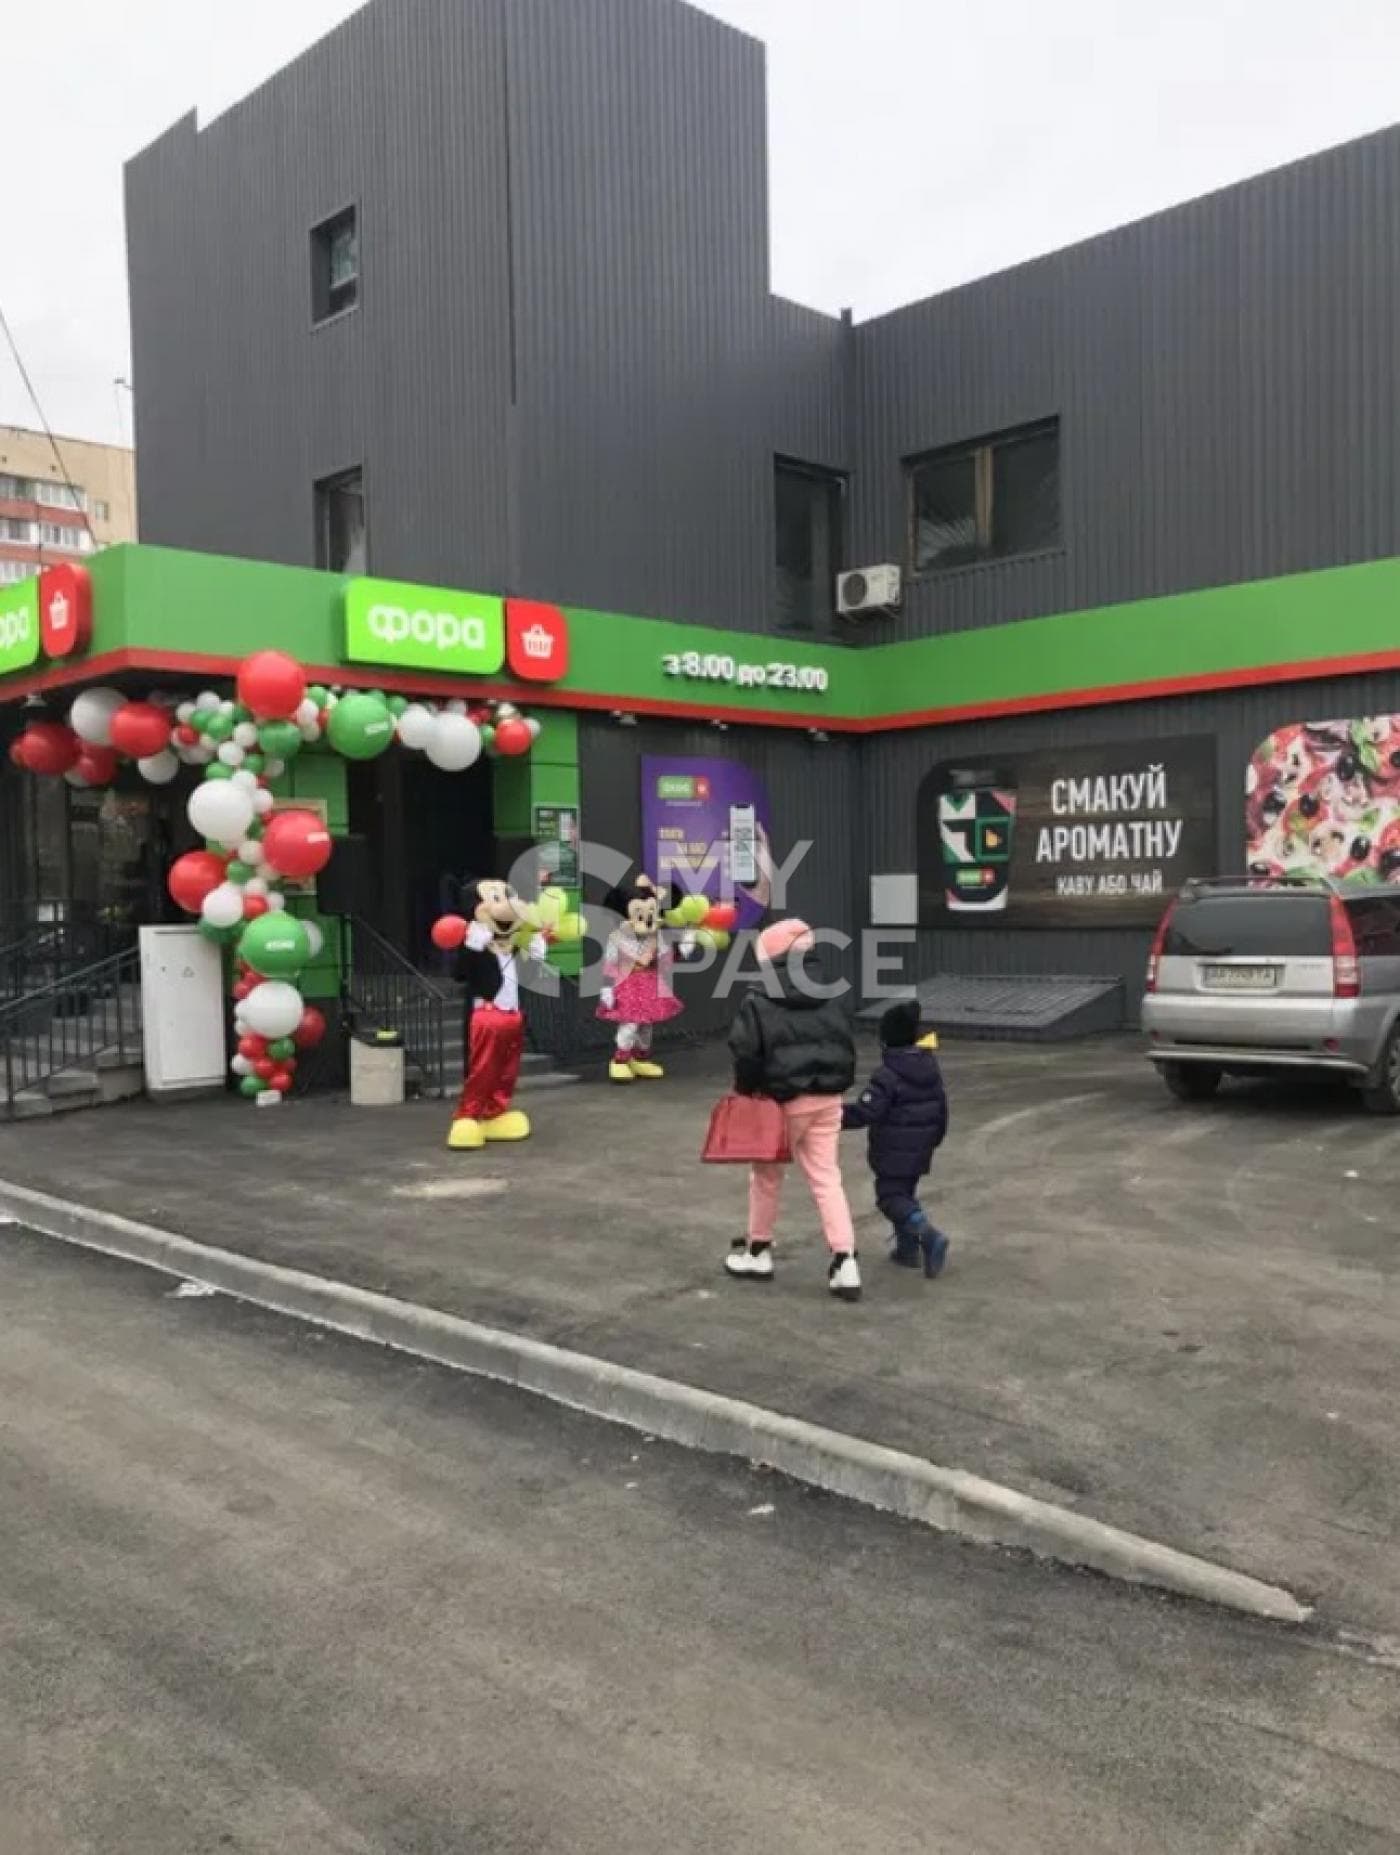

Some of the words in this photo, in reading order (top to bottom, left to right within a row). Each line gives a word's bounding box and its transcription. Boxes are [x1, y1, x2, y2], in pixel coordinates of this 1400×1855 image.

[736, 663, 766, 688] до
[1051, 762, 1167, 816] СМАКУЙ
[1035, 818, 1184, 864] АРОМАТНУ
[1057, 874, 1095, 896] КАВУ
[1099, 874, 1128, 896] АБО
[1130, 867, 1163, 895] ЧАЙ
